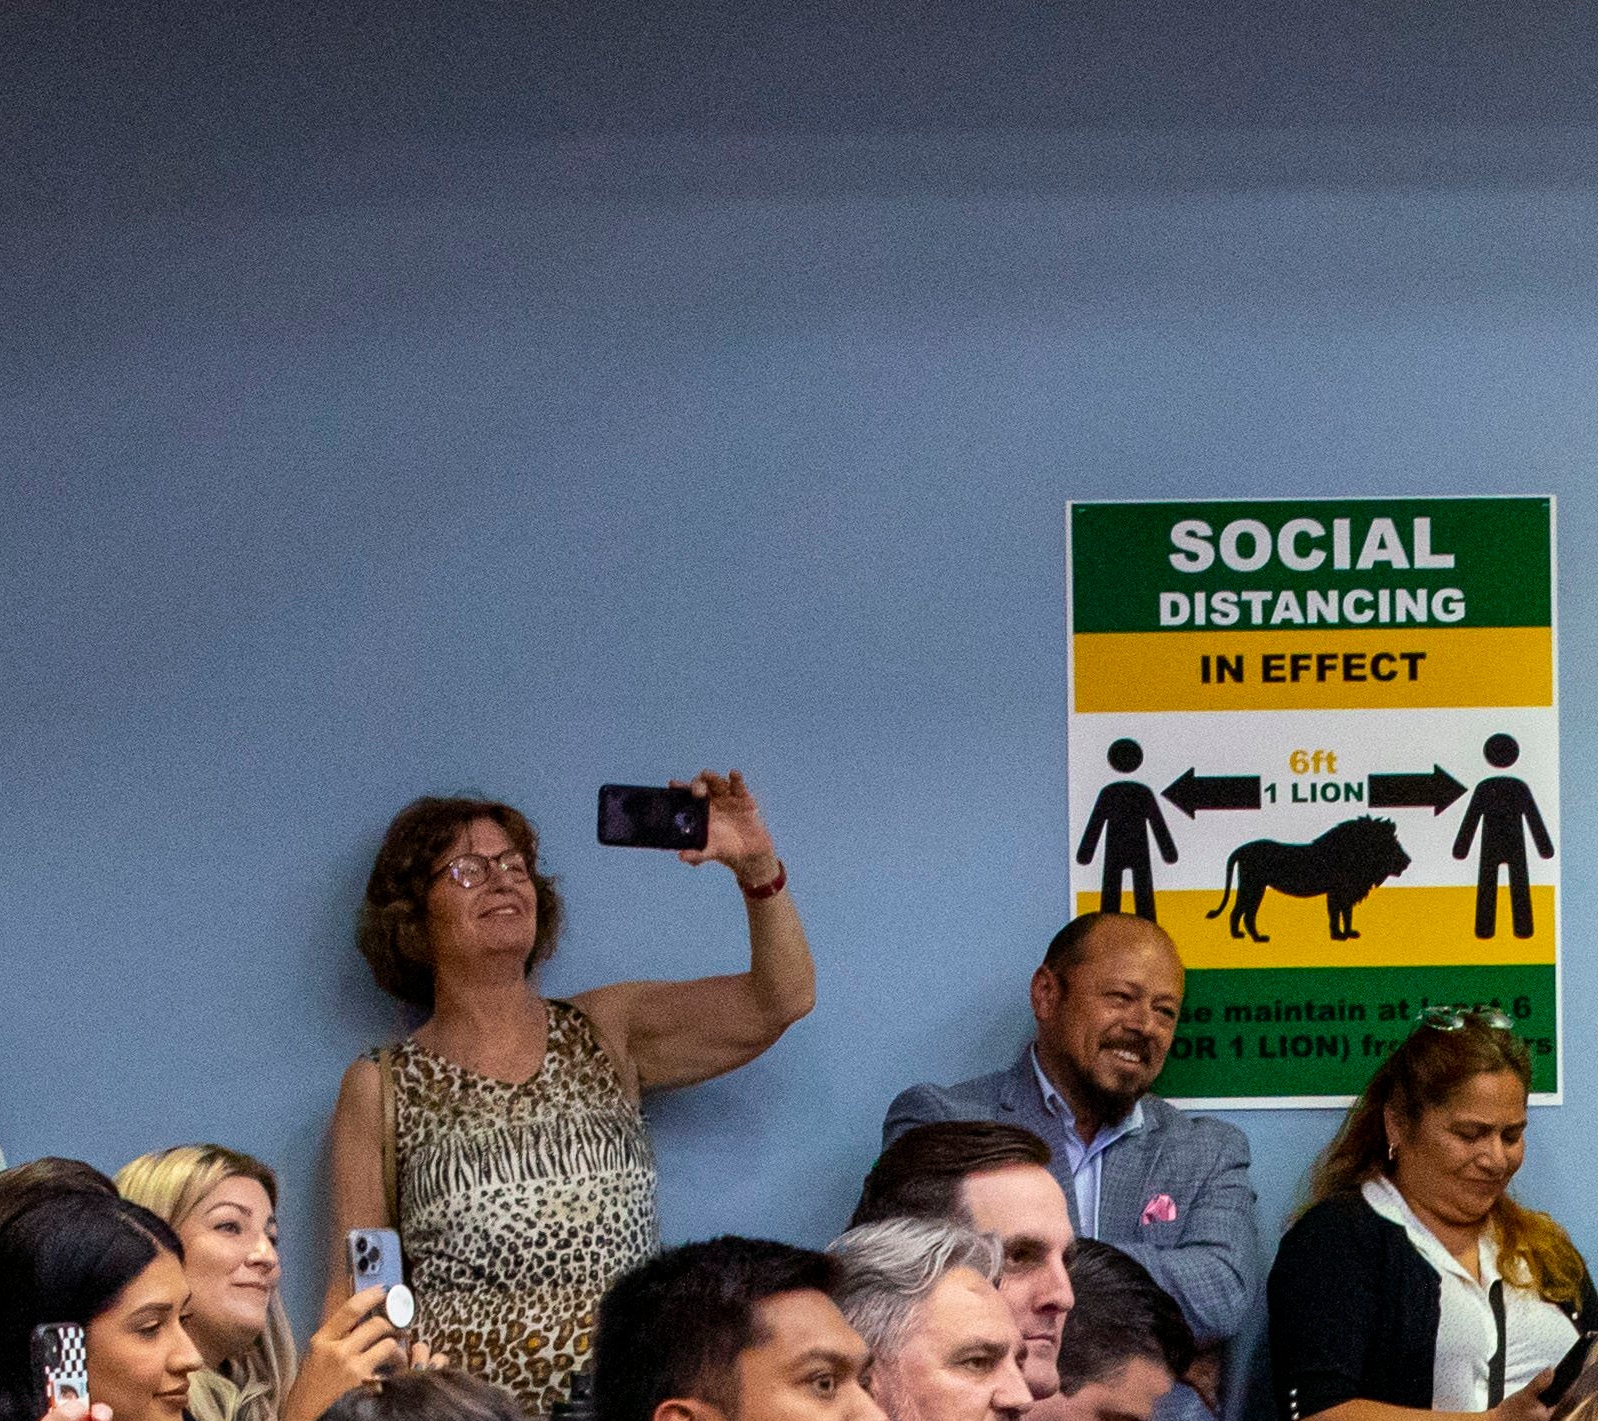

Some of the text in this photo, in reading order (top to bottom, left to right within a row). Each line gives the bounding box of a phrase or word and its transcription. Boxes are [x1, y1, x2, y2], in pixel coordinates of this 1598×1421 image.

[1168, 516, 1456, 573] SOCIAL
[1159, 588, 1467, 627] DISTANCING
[1201, 652, 1428, 684] IN EFFECT
[1289, 749, 1338, 775] 6ft
[1264, 780, 1365, 804] 1 LION
[1224, 1002, 1366, 1024] maintain
[1378, 1001, 1409, 1022] at
[1512, 996, 1532, 1019] 6
[1171, 1035, 1216, 1060] OR
[1231, 1036, 1243, 1058] 1
[1258, 1034, 1351, 1062] LION)
